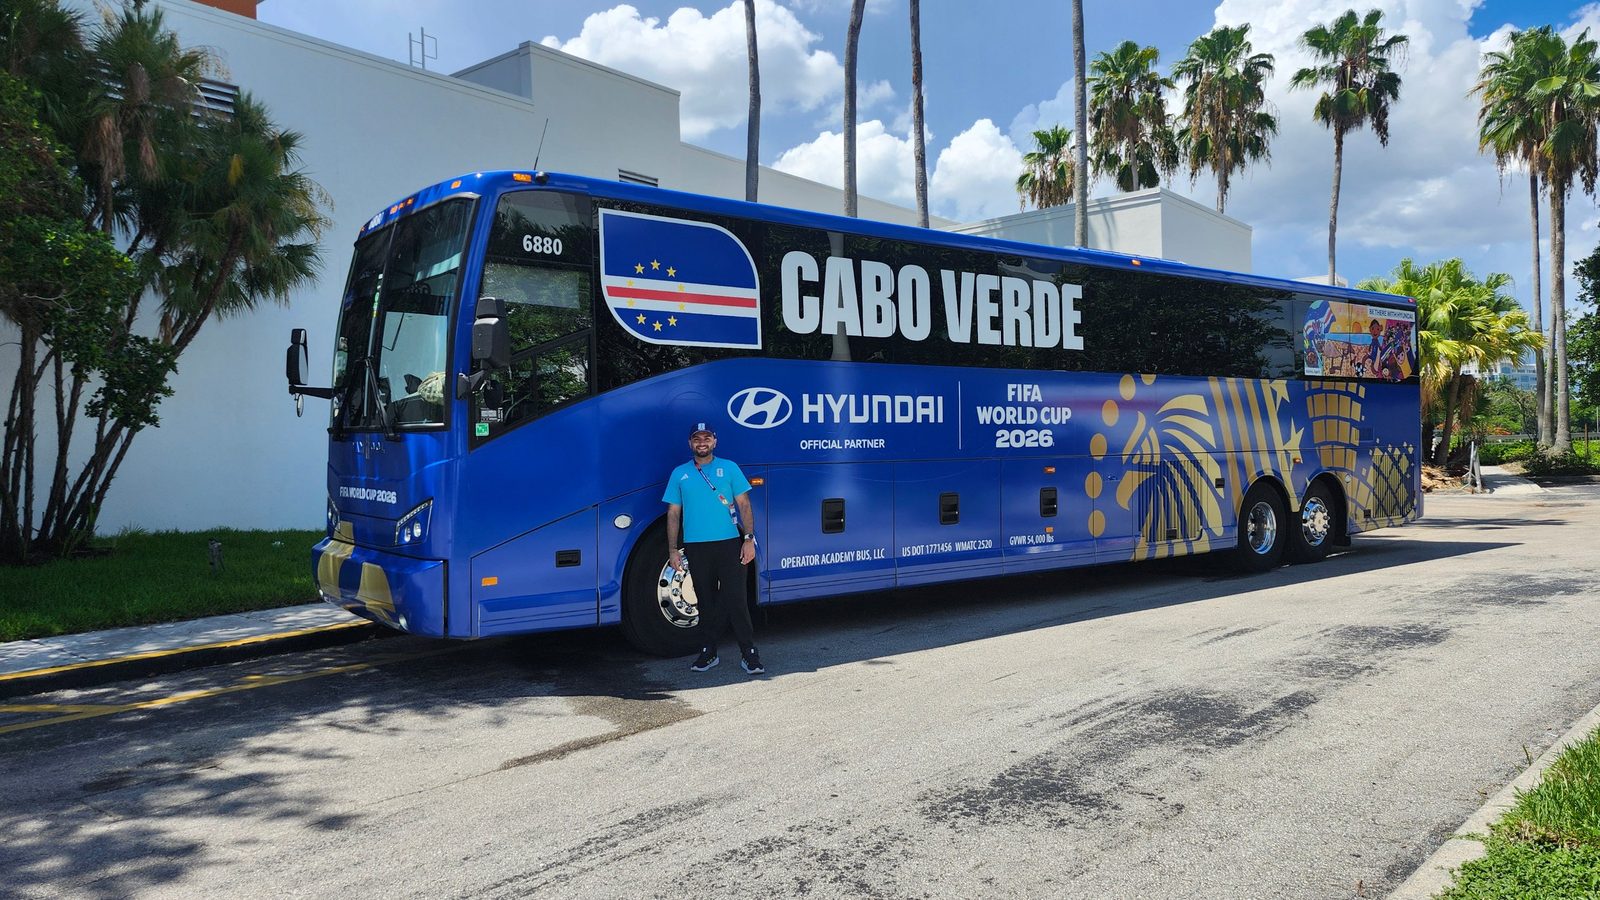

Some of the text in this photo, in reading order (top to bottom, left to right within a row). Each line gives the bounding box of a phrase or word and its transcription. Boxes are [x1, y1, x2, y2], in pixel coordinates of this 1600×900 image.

[522, 234, 563, 256] 6880
[780, 250, 1085, 350] CABO VERDE
[1007, 383, 1043, 402] FIFA
[802, 393, 944, 424] HYUNDAI
[976, 406, 1072, 425] WORLD CUP
[800, 438, 885, 450] OFFICIAL PARTNER
[995, 429, 1054, 448] 2026
[340, 486, 397, 504] FIFA WORLD CUP 2026
[902, 539, 993, 557] US DOT 1771456 WMATC 2520
[1009, 535, 1026, 546] GVWR
[1027, 534, 1045, 545] 54,000
[781, 547, 885, 569] OPERATOR ACADEMY BUS, LLC
